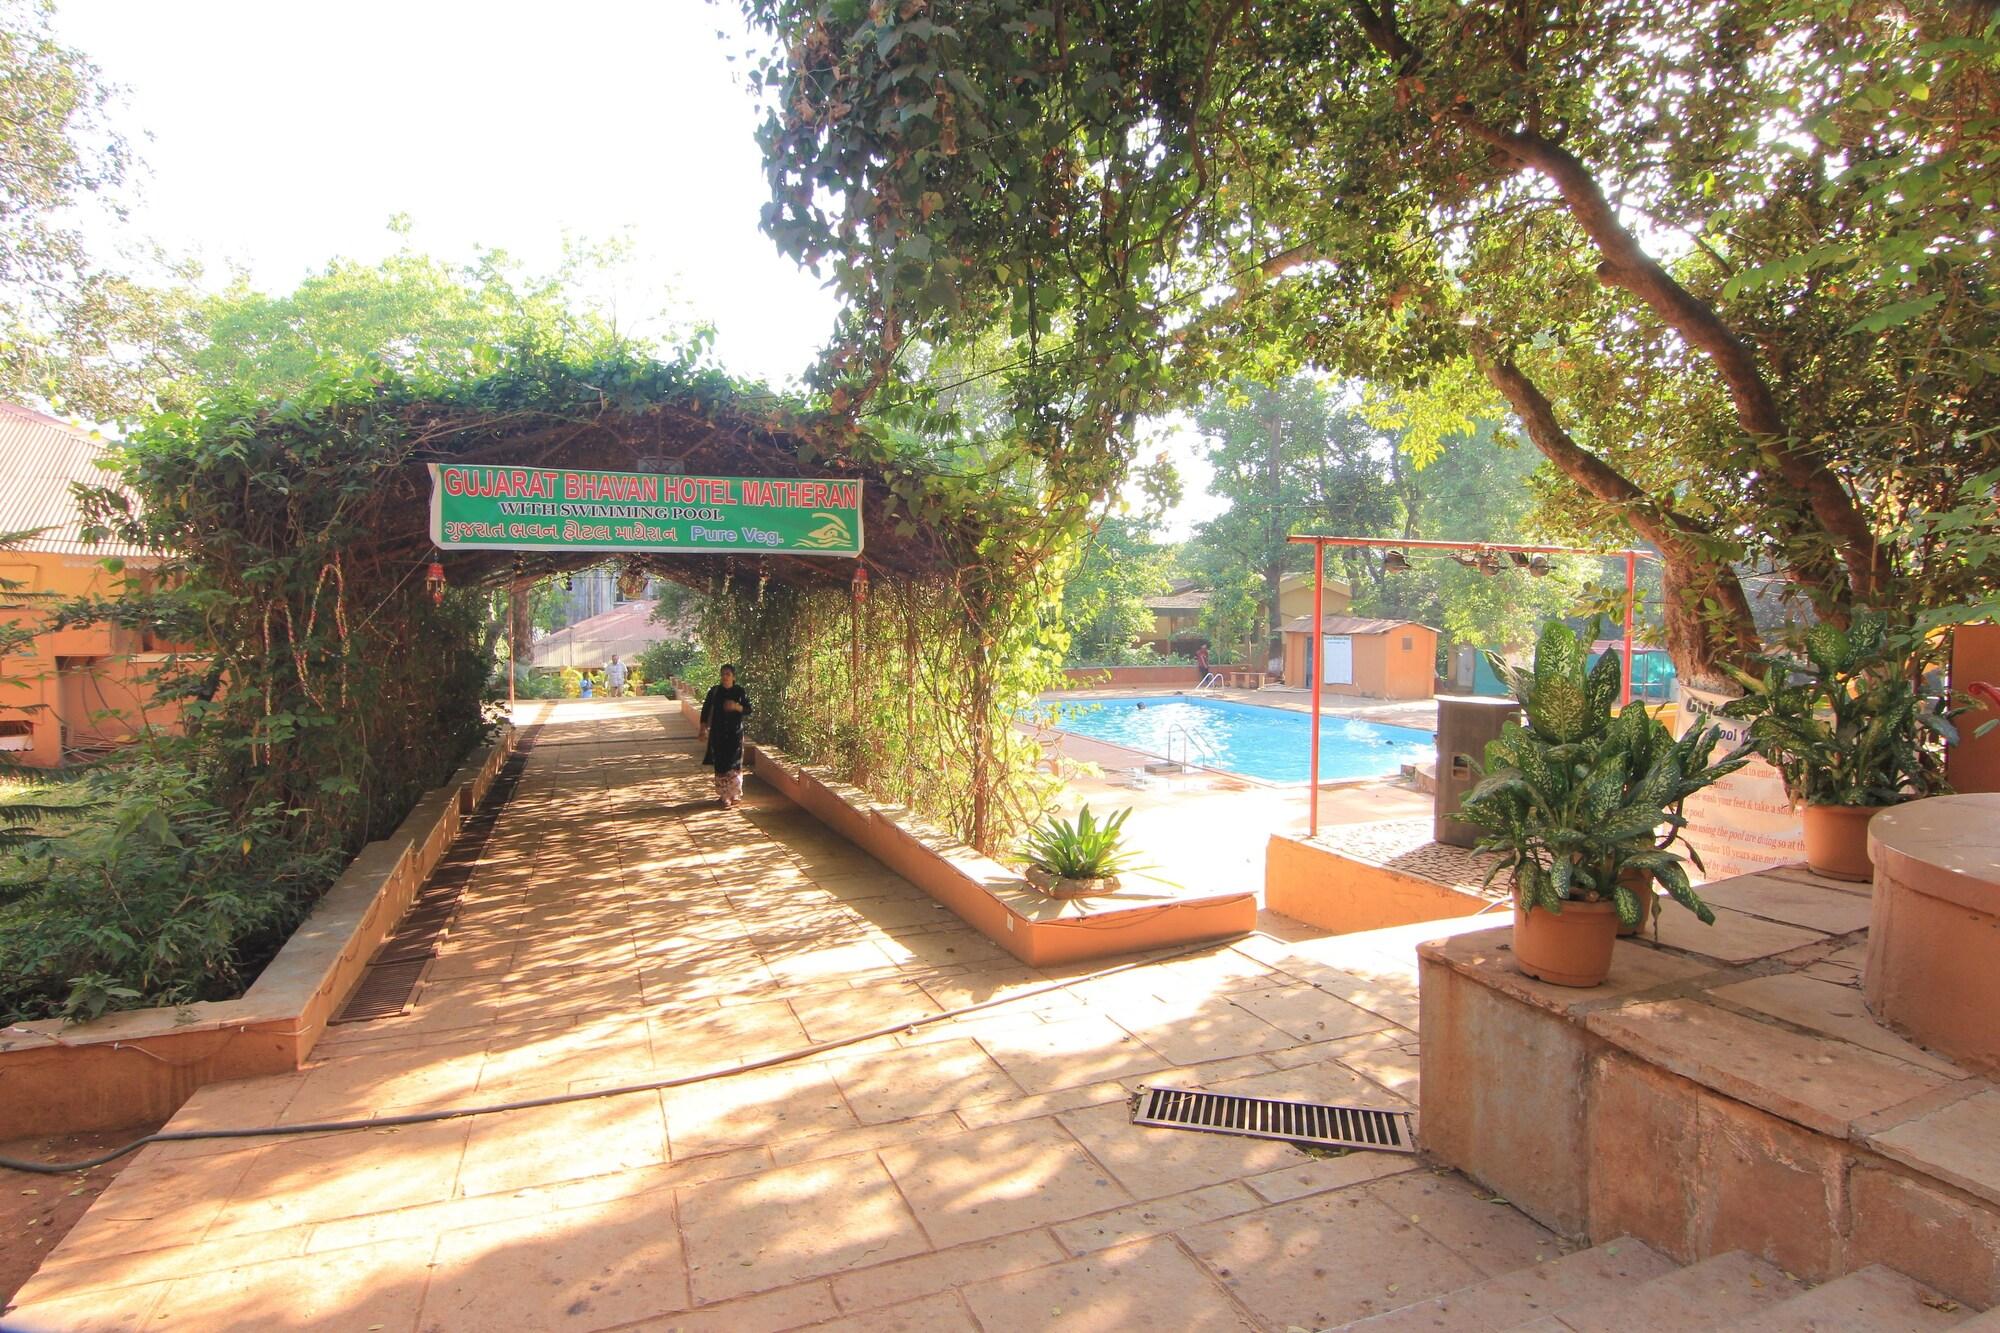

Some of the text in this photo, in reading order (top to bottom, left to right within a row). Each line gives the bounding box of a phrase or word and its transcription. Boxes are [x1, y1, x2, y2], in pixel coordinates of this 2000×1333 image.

[444, 468, 857, 509] GUJARAT BHAVAN HOTEL MATHERAN
[500, 502, 725, 521] WITH SWIMMING POOL
[445, 520, 678, 543] ગુજરાત ભવન હોટલ માથેરાન
[690, 525, 785, 546] Pure Veg.
